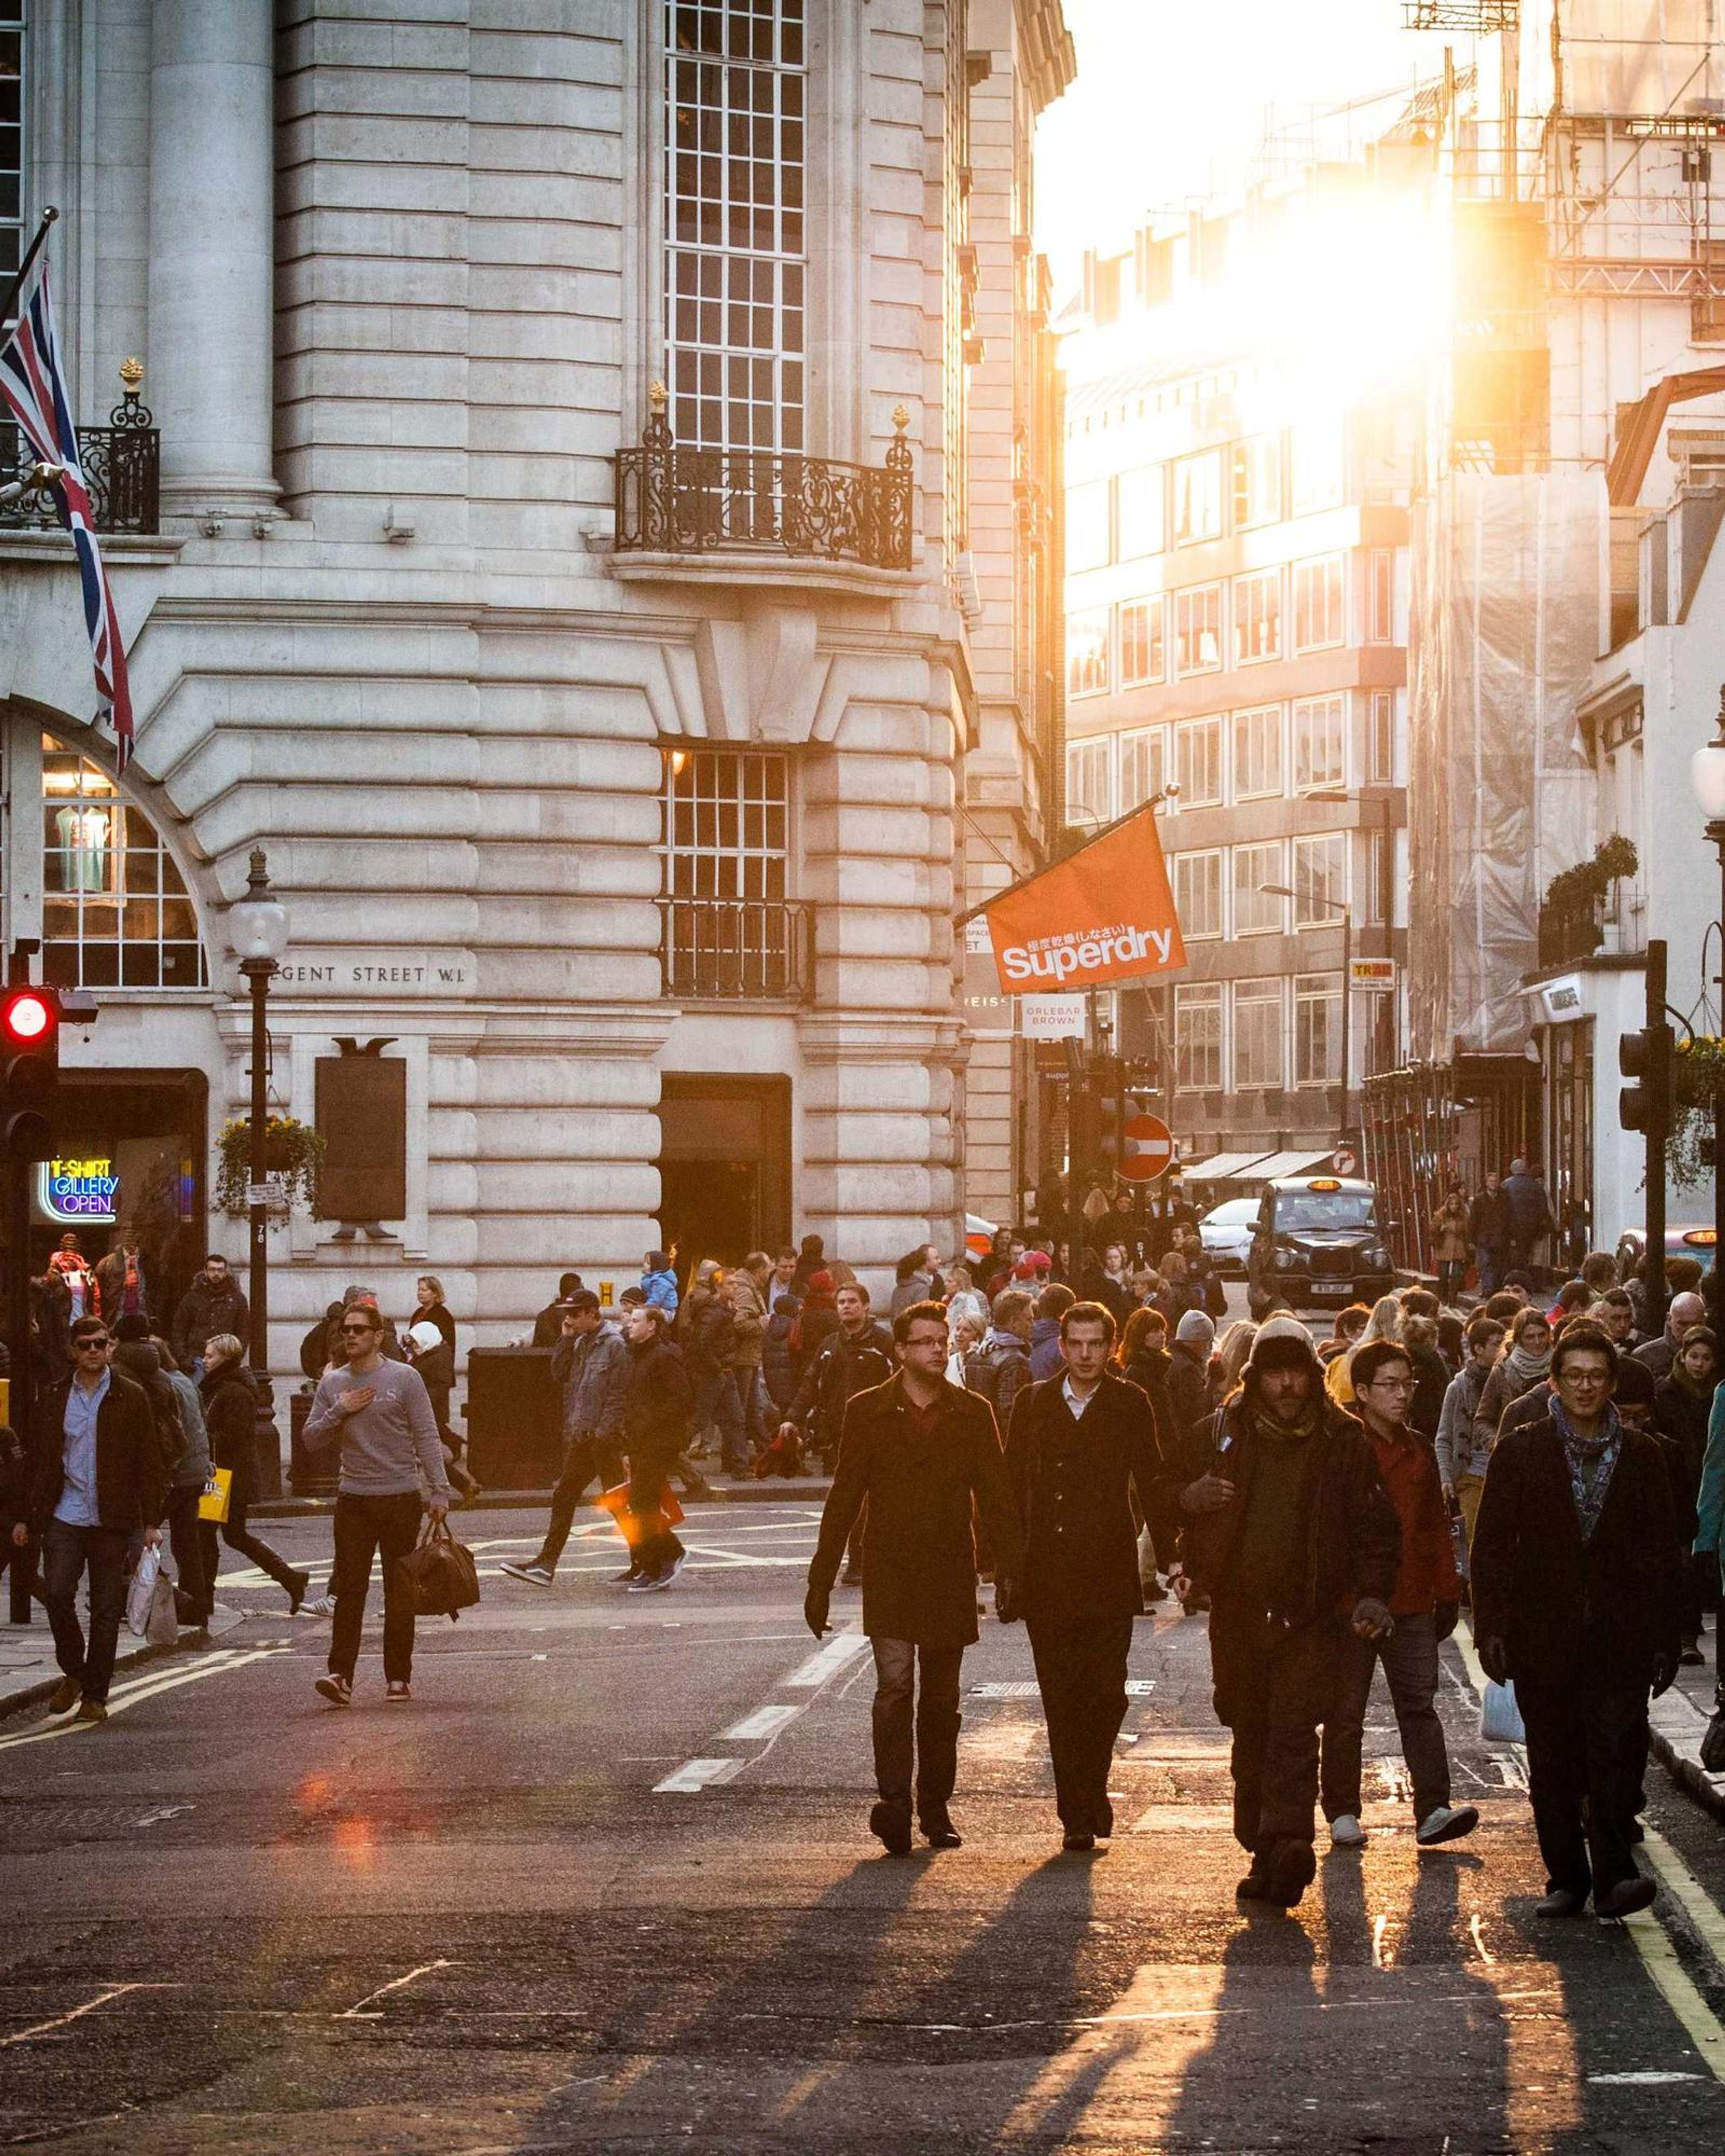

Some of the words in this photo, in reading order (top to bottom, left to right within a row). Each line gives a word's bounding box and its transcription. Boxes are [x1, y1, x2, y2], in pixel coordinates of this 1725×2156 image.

[966, 941, 980, 950] ET
[1003, 926, 1172, 981] Superdry
[271, 967, 335, 981] GENT
[353, 967, 425, 981] STREET
[1026, 1007, 1080, 1016] ORLEBAR
[51, 1160, 111, 1178] T-SHIRT
[55, 1177, 119, 1195] GALLERY
